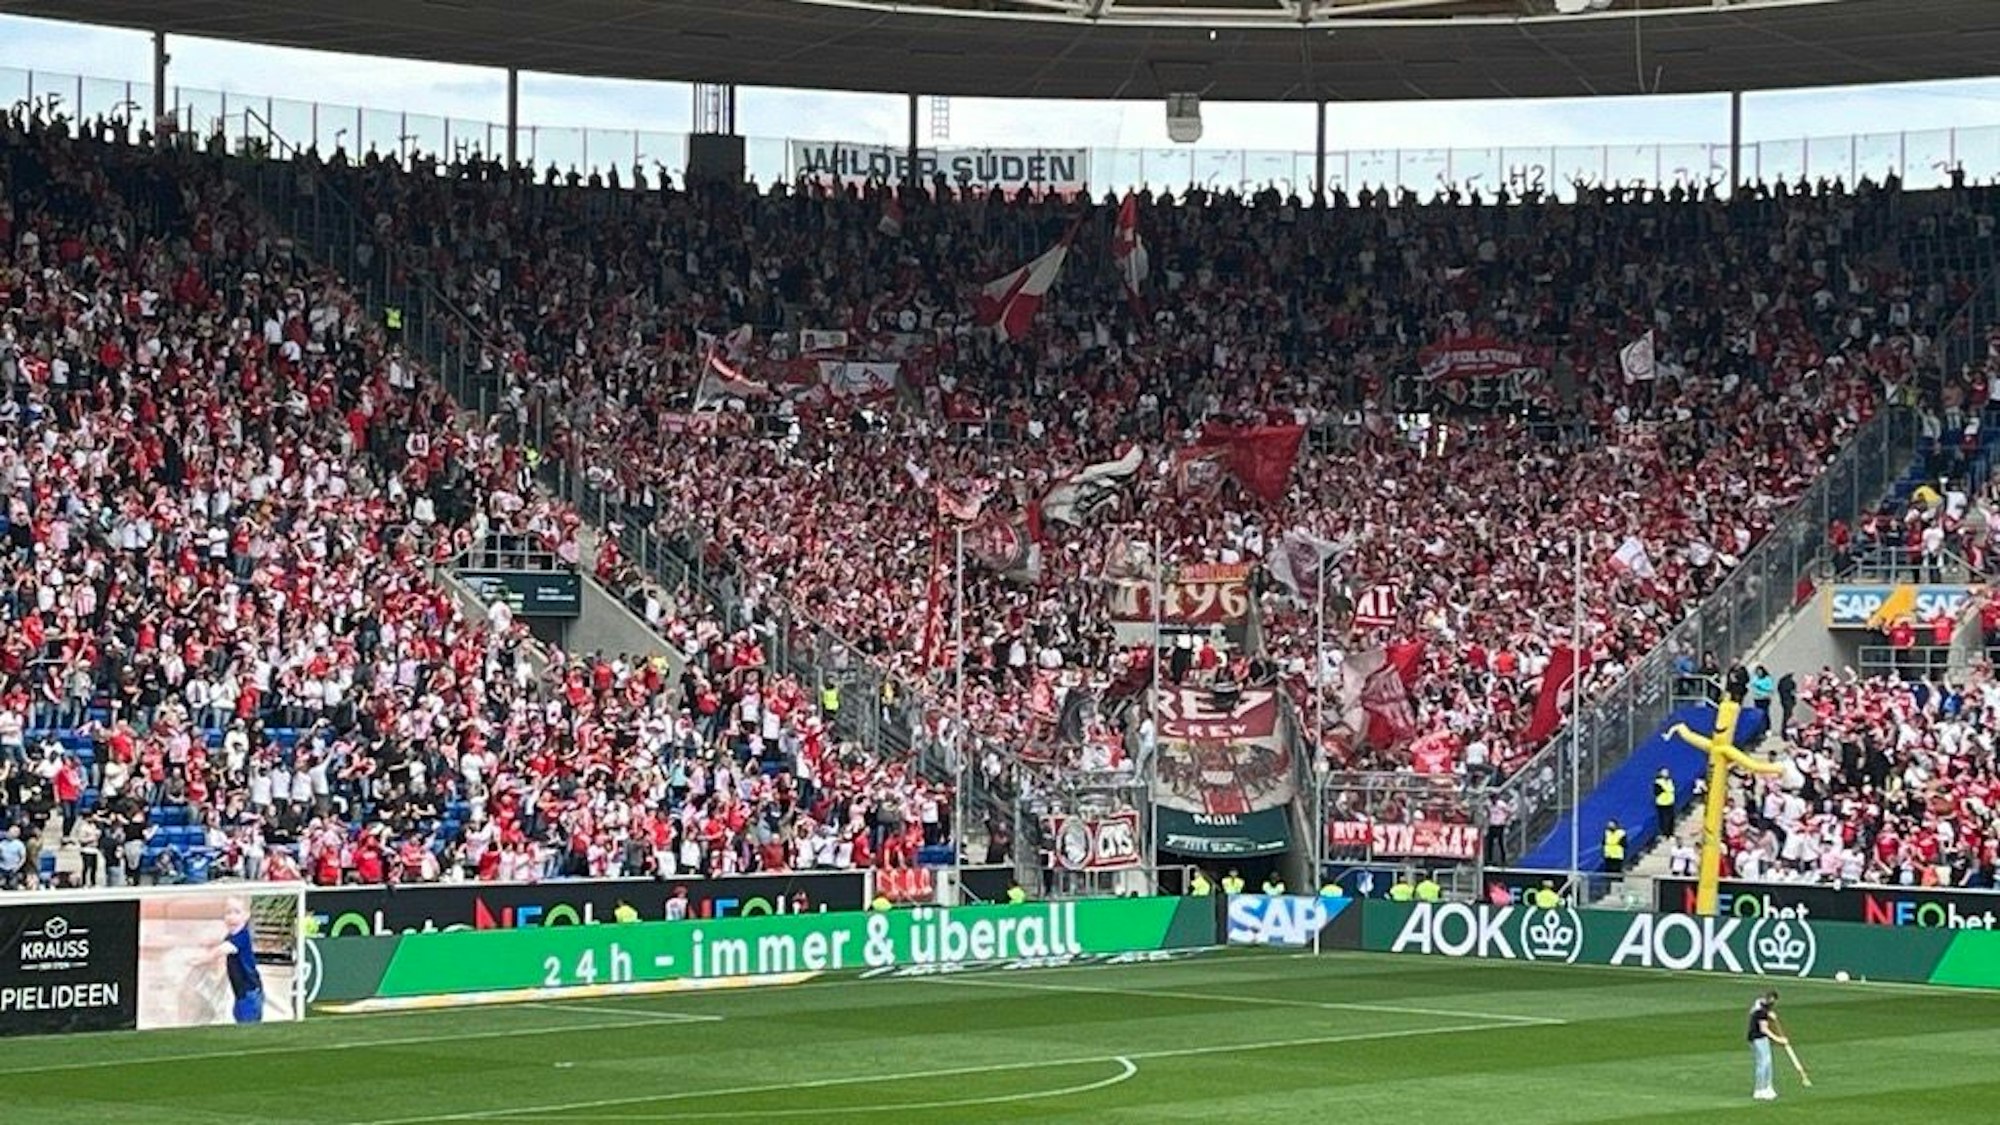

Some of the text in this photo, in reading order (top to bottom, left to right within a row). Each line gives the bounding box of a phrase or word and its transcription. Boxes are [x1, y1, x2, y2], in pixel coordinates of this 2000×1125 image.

[1833, 594, 1882, 620] SAP
[1162, 722, 1248, 737] CREW
[1228, 895, 1328, 944] SAP
[1391, 902, 1516, 958] AOK
[20, 939, 90, 960] KRAUSS
[692, 929, 850, 978] immer
[863, 913, 896, 966] &
[911, 902, 1081, 963] überall
[1610, 912, 1743, 973] AOK
[0, 982, 119, 1012] PIELIDEEN
